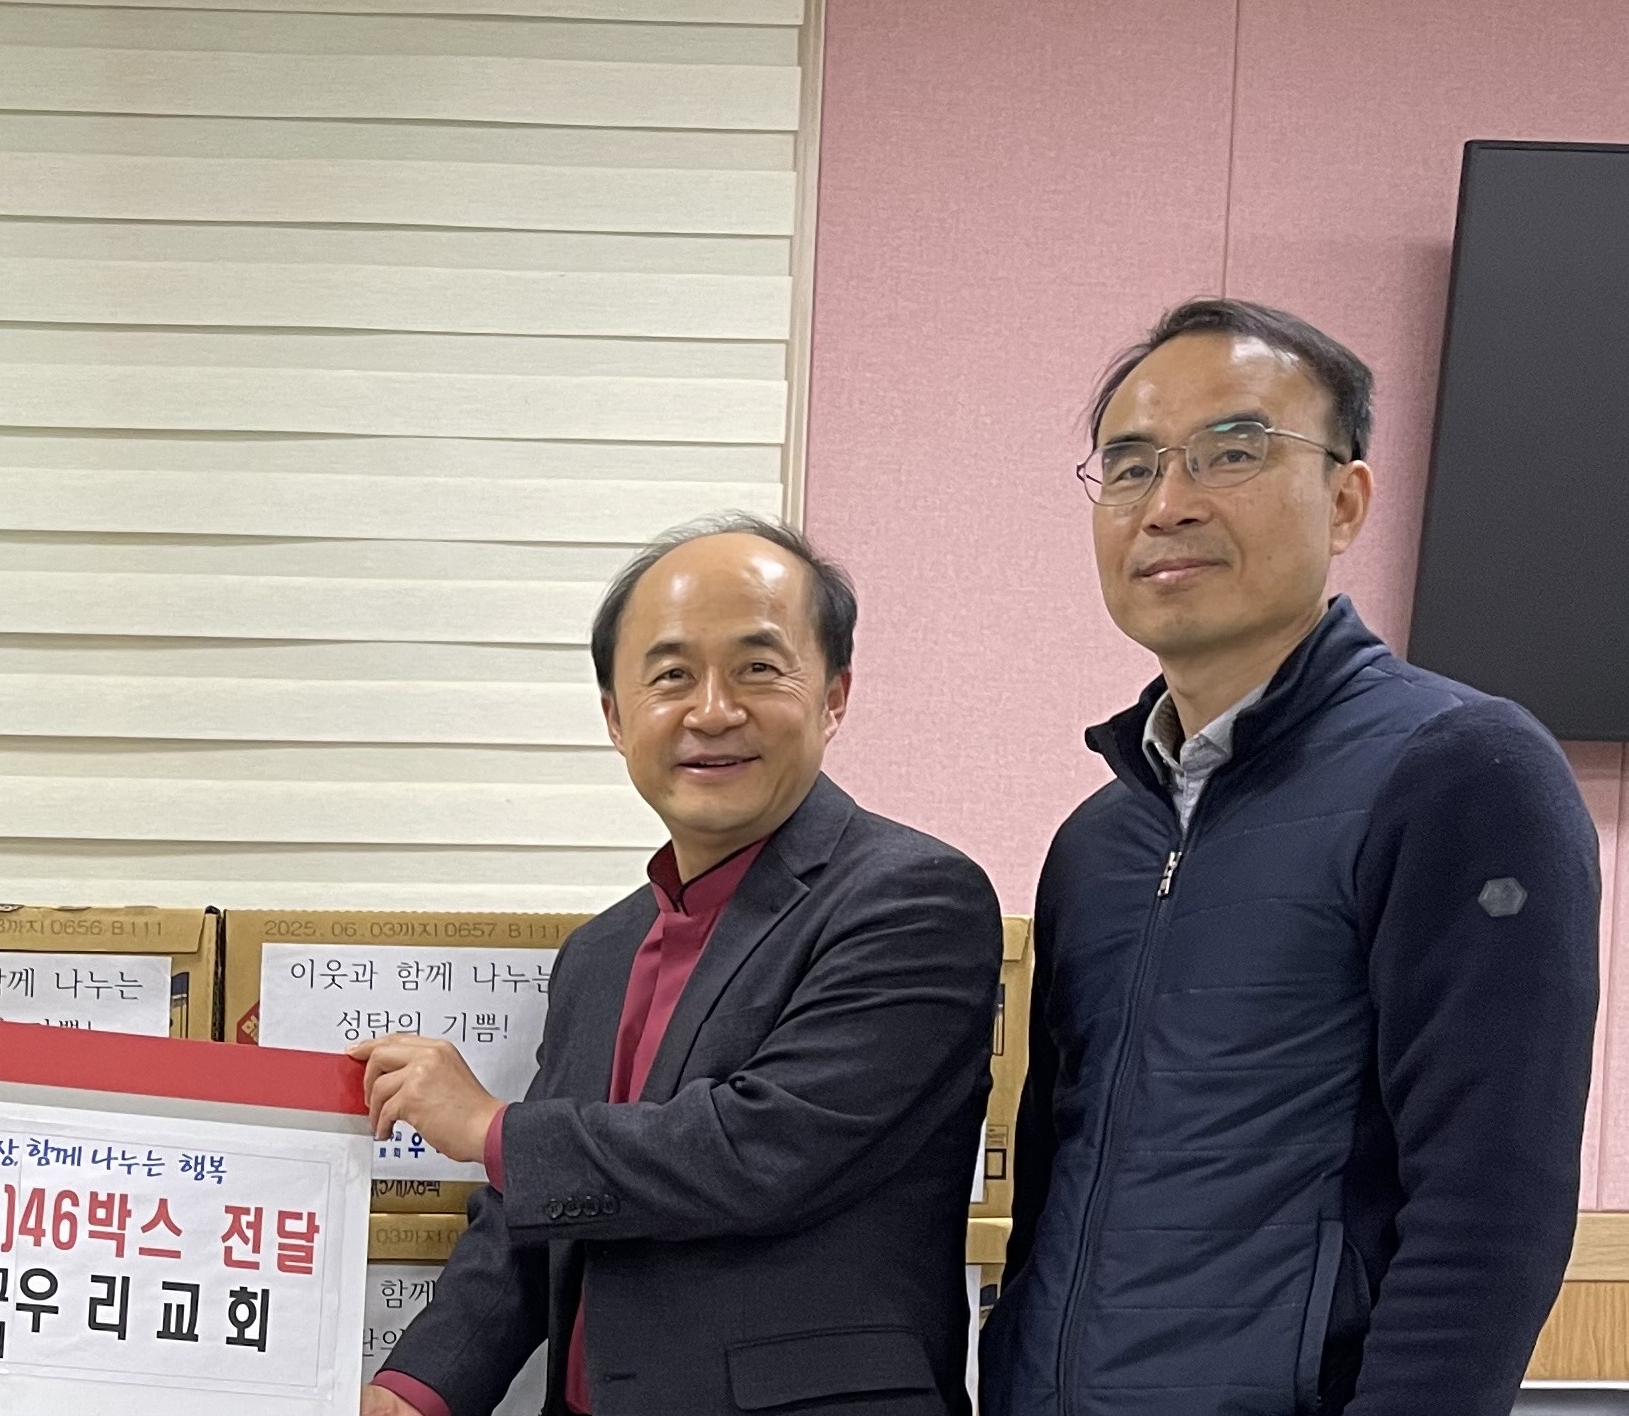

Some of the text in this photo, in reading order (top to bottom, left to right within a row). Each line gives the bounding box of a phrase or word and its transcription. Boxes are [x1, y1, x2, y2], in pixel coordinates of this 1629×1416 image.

[54, 968, 144, 1001] 나누는
[290, 958, 379, 991] 이웃과
[396, 960, 453, 993] 함께
[441, 1011, 509, 1043] 기쁨!
[26, 1134, 83, 1167] 함께
[90, 1145, 171, 1178] 나누는
[178, 1153, 228, 1185] 행복
[221, 1203, 321, 1275] 전달
